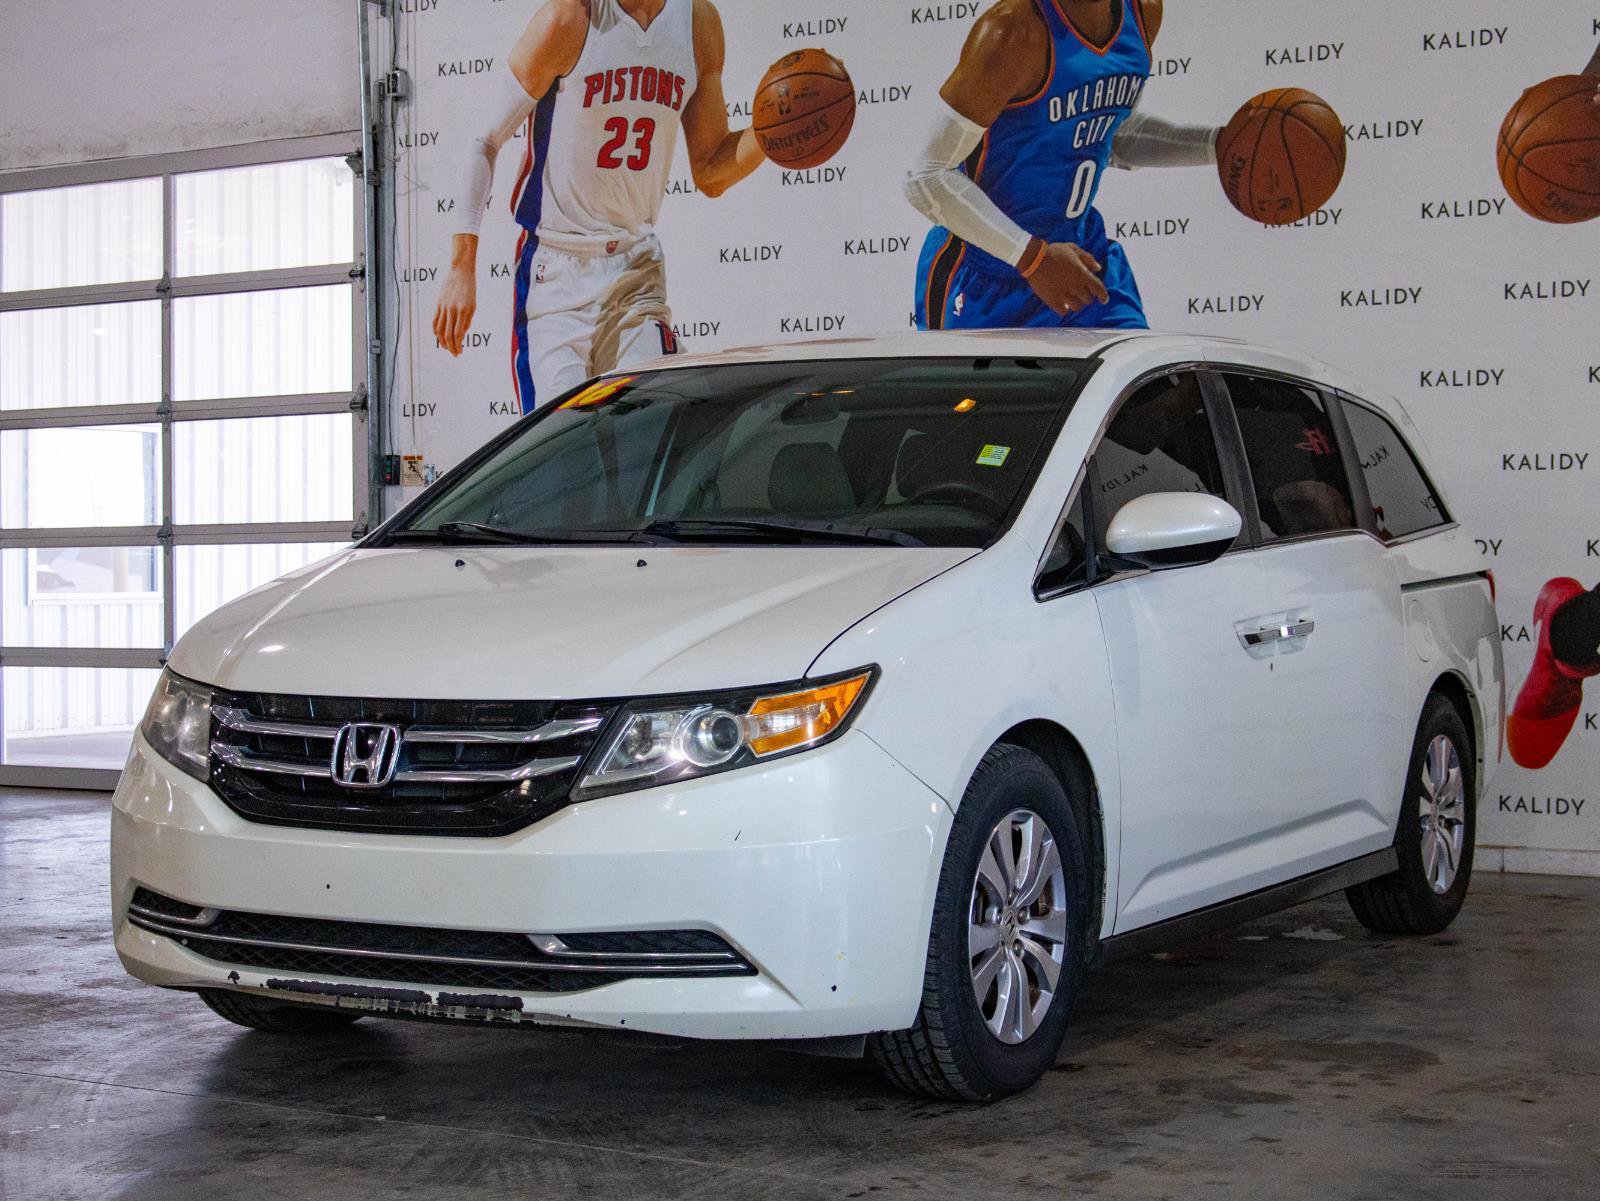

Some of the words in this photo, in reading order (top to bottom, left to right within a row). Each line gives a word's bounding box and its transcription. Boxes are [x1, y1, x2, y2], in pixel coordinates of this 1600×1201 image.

[912, 2, 980, 24] KALIDY
[784, 17, 847, 38] KALIDY
[1424, 27, 1507, 51] KALIDY
[1265, 43, 1343, 65] KALIDY
[438, 58, 493, 77] KALIDY
[583, 66, 685, 111] PISTONS
[858, 85, 911, 105] ALIDY
[1049, 75, 1142, 122] OKLAHOM
[1073, 115, 1116, 149] CITY
[1343, 119, 1423, 141] KALIDY
[597, 116, 656, 171] 23
[782, 166, 846, 186] KALIDY
[1066, 160, 1097, 219] 0
[1421, 198, 1505, 219] KALIDY
[1116, 218, 1190, 238] KALIDY
[720, 245, 782, 263] KALIDY
[845, 236, 910, 255] KALIDY
[1341, 287, 1422, 307] KALIDY
[1504, 279, 1590, 300] KALIDY
[1188, 295, 1264, 314] KALIDY
[673, 322, 720, 337] ALIDY
[781, 316, 845, 333] KALIDY
[1420, 369, 1504, 388] KALIDY
[403, 402, 436, 418] LIDY
[1502, 453, 1589, 471] KALIDY
[1499, 795, 1585, 816] KALIDY
